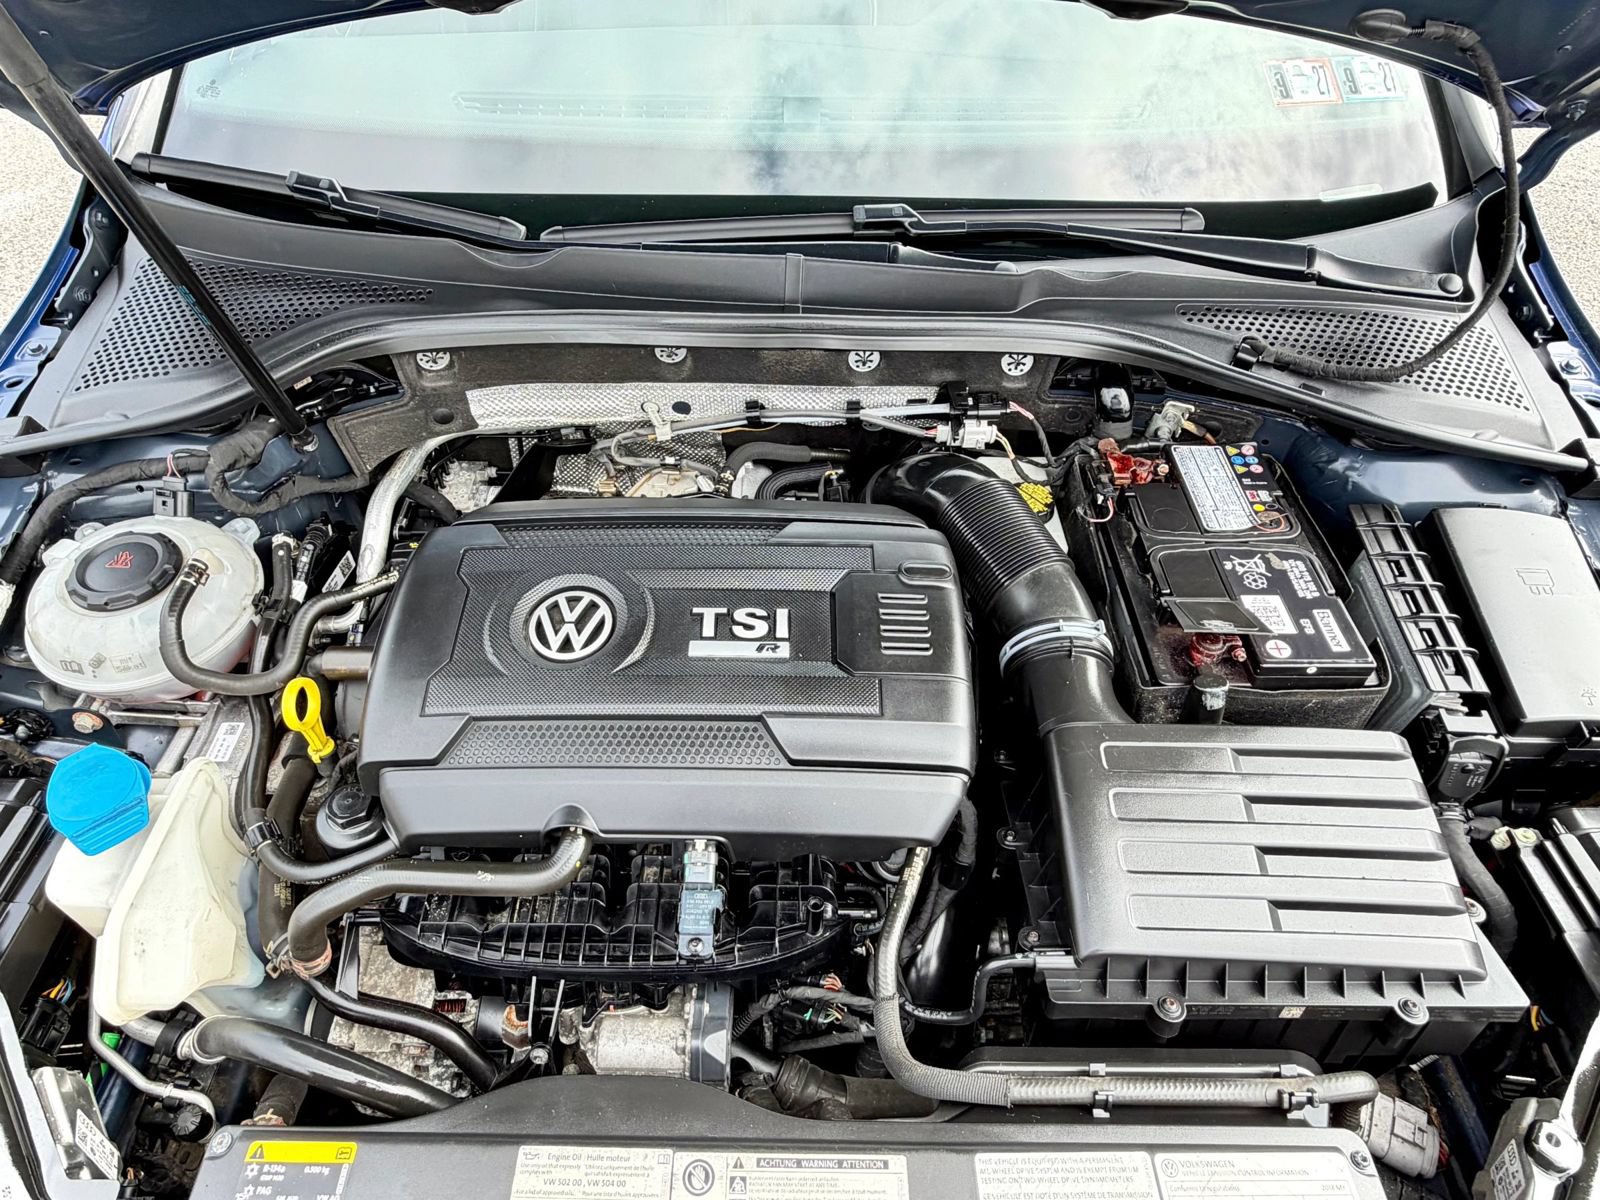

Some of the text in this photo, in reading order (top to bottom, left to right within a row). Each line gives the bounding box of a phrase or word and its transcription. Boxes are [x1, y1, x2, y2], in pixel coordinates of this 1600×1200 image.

[1312, 64, 1331, 97] 27
[1343, 62, 1397, 95] 9 27
[529, 590, 613, 660] VW
[691, 607, 789, 639] TSI
[1317, 611, 1344, 649] Banner
[755, 643, 781, 653] R
[547, 1152, 571, 1162] Engine
[572, 1153, 582, 1161] Oil
[606, 1154, 631, 1162] moteur
[759, 1159, 884, 1169] ACHTUNG WARNING ATTENTION
[1178, 1159, 1235, 1168] VOLKSWAGEN
[543, 1178, 557, 1186] VW
[557, 1178, 571, 1186] 502
[587, 1179, 600, 1187] VW
[601, 1179, 615, 1188] 504
[616, 1180, 627, 1188] 00
[255, 1186, 272, 1195] PAG
